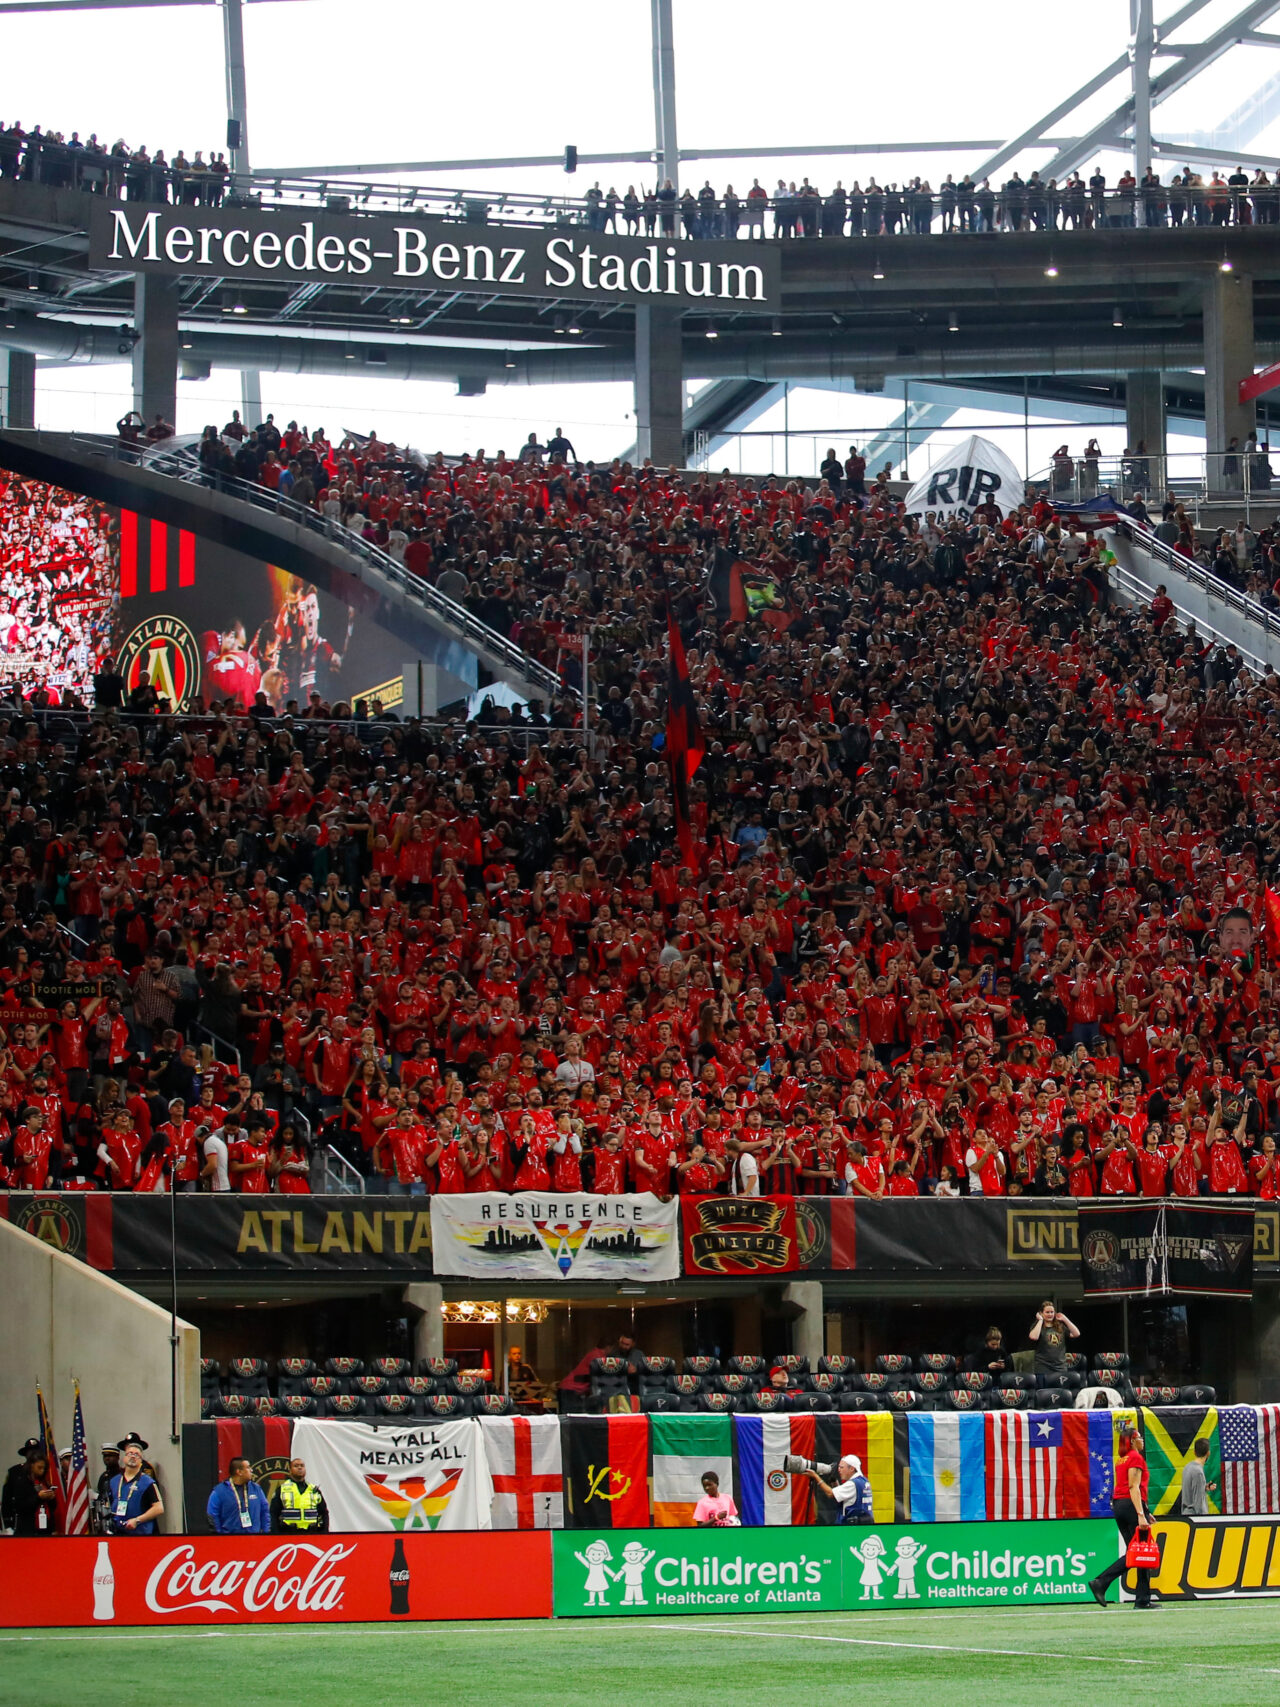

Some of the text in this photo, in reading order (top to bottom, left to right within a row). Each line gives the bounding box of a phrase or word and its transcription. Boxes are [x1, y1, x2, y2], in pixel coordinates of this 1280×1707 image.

[109, 208, 767, 301] Mercedes-Benz Stadium
[926, 465, 1002, 507] RIP
[128, 619, 189, 655] ATLANTA
[567, 633, 583, 644] 136
[37, 986, 96, 994] FOOTIE MOB
[25, 1200, 71, 1218] ATLANTA
[481, 1202, 643, 1221] RESURGENCE
[715, 1204, 761, 1219] HAIL
[237, 1210, 432, 1254] ATLANTA
[704, 1236, 776, 1251] UNITED
[391, 1431, 440, 1448] Y'ALL
[360, 1445, 467, 1465] MEANS ALL.
[654, 1554, 822, 1587] Children's
[926, 1547, 1087, 1580] Children's
[145, 1542, 359, 1614] Coca-Cola
[656, 1589, 821, 1605] Healthcare of Atlanta
[928, 1581, 1087, 1598] Healthcare of Atlanta
